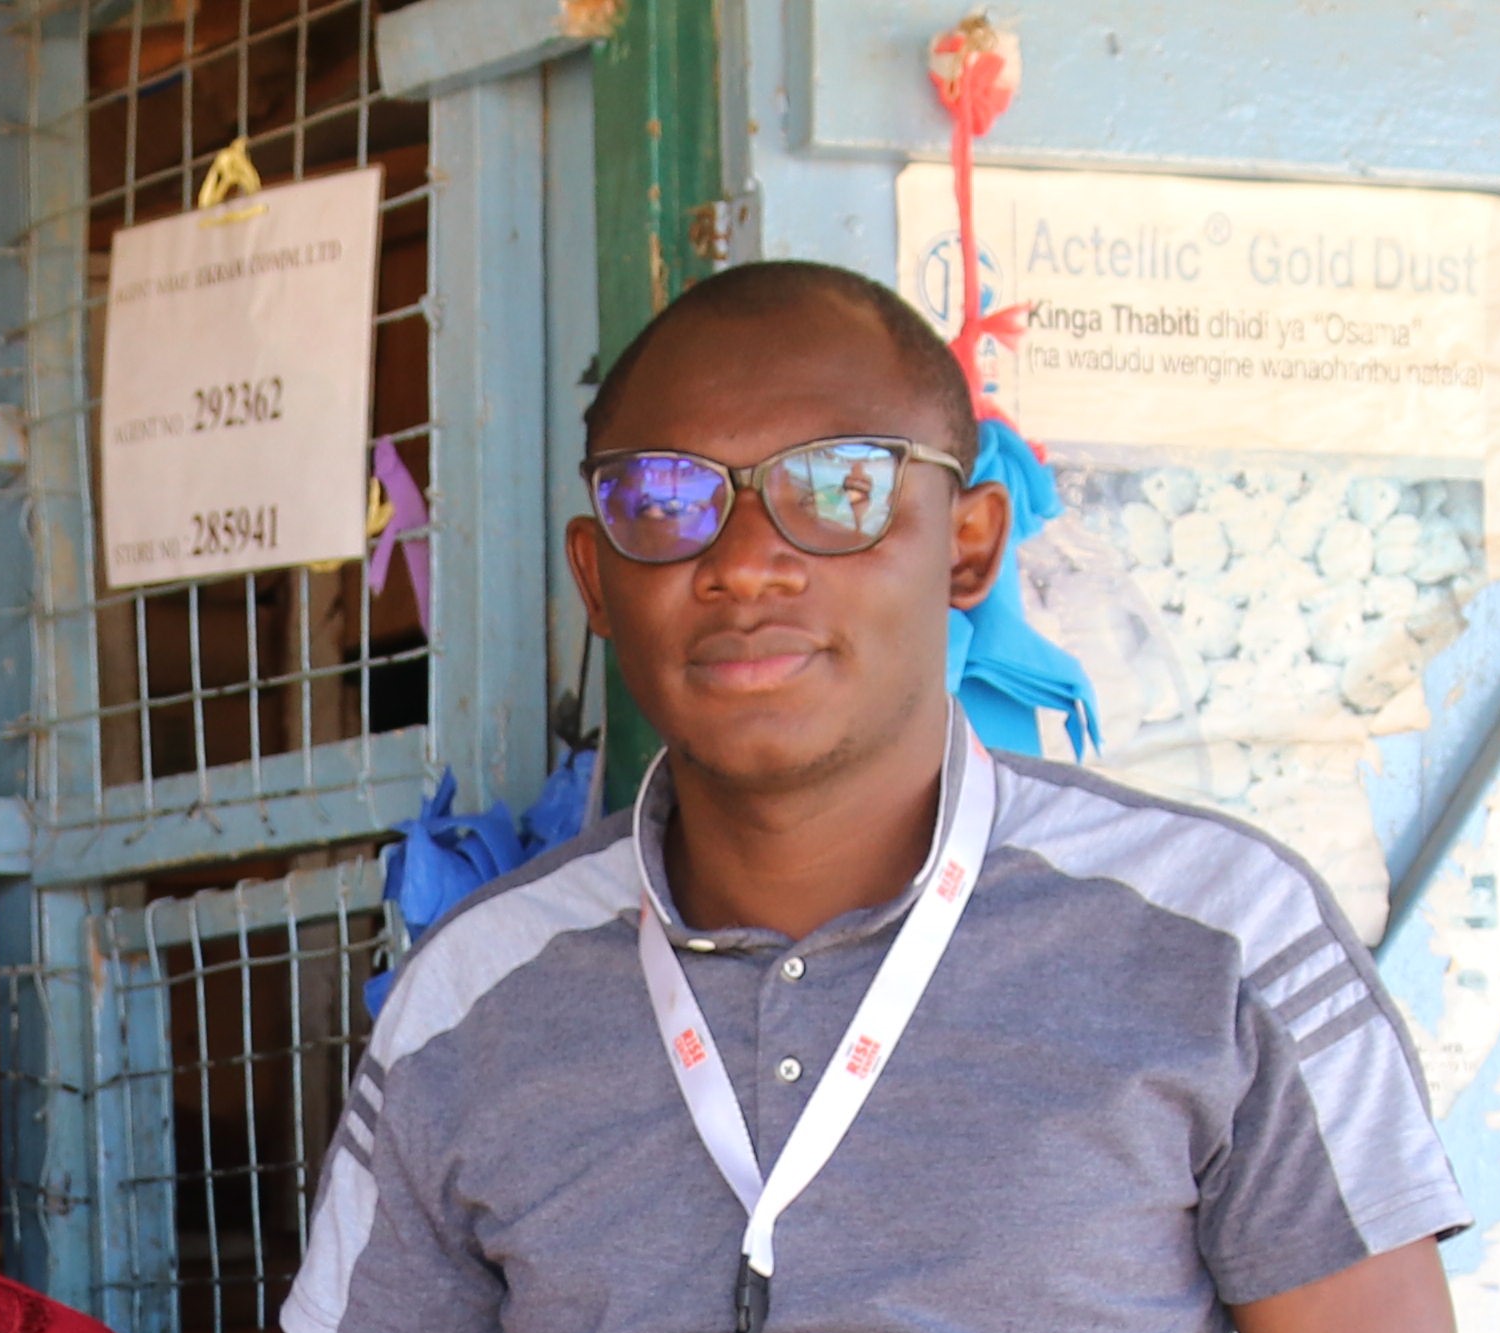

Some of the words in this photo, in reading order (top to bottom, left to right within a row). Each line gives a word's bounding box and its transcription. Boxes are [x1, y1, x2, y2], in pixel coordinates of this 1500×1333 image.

[1247, 233, 1356, 289] Gold
[1372, 236, 1480, 297] Dust
[1027, 300, 1103, 339] Kinga
[1109, 303, 1201, 340] Thabiti
[1067, 344, 1155, 375] wadudu
[1161, 350, 1255, 384] wengine
[190, 373, 287, 434] 292362
[190, 501, 281, 558] 285941
[683, 1027, 709, 1064] RISE
[845, 1034, 874, 1075] RISE
